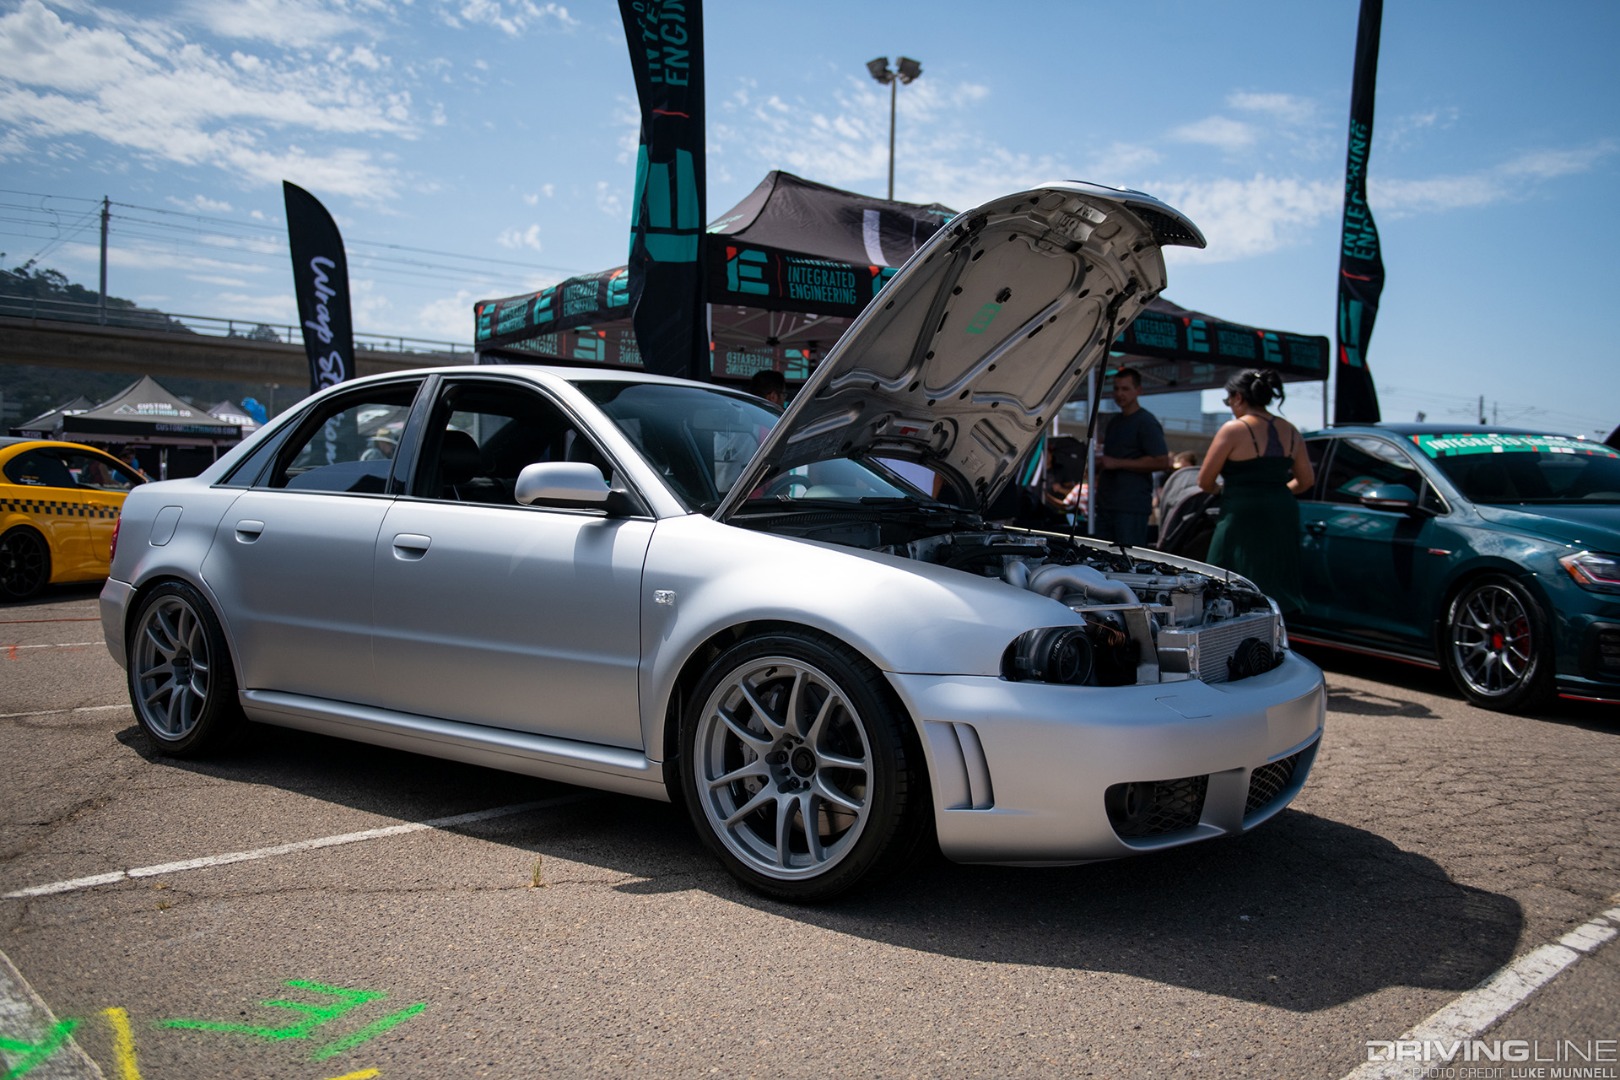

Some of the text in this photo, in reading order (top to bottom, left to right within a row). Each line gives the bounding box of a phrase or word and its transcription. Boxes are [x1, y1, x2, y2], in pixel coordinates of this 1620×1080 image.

[788, 265, 856, 289] INTEGRATED
[304, 255, 337, 344] Wrap
[789, 283, 857, 305] ENGINEERING
[138, 408, 179, 416] CLOTHING
[1426, 436, 1520, 450] INTEGRATED
